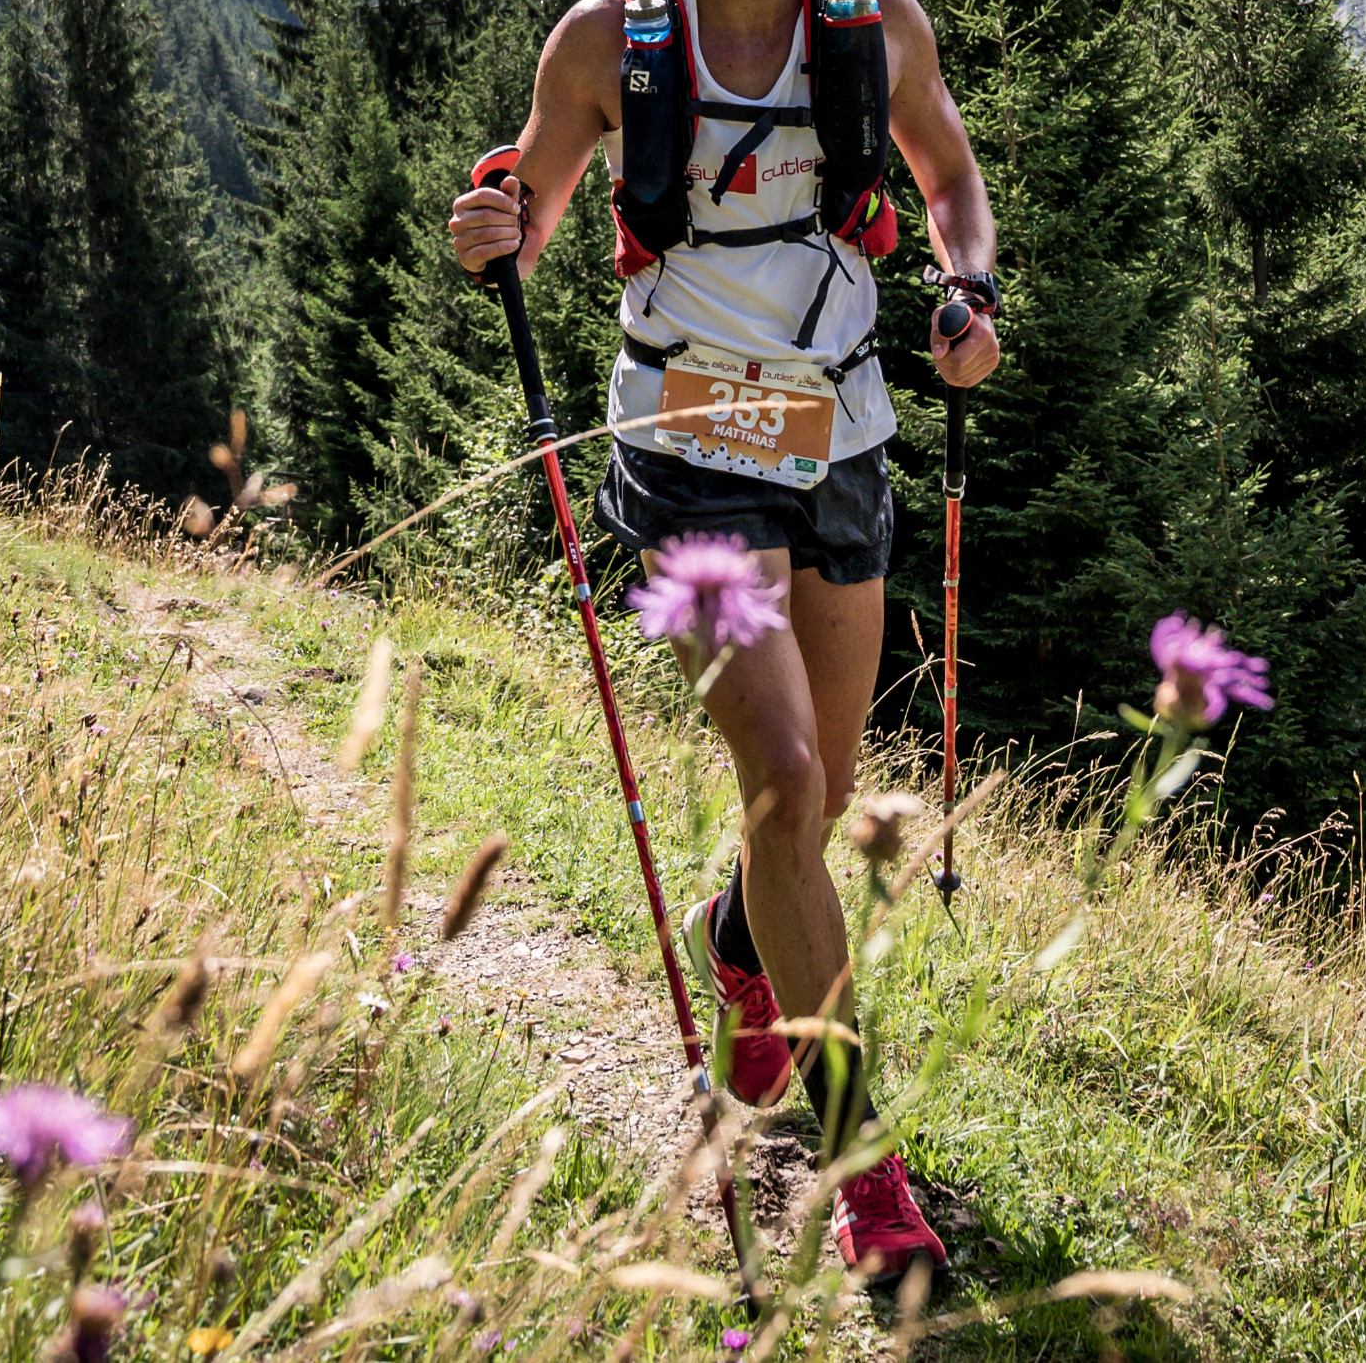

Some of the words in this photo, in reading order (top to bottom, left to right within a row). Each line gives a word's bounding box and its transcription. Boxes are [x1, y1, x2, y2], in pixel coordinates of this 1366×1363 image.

[712, 361, 744, 374] allgäu
[762, 371, 795, 383] outlet
[706, 381, 788, 436] 353
[712, 424, 777, 449] MATTHIAS
[569, 542, 578, 564] LEKI
